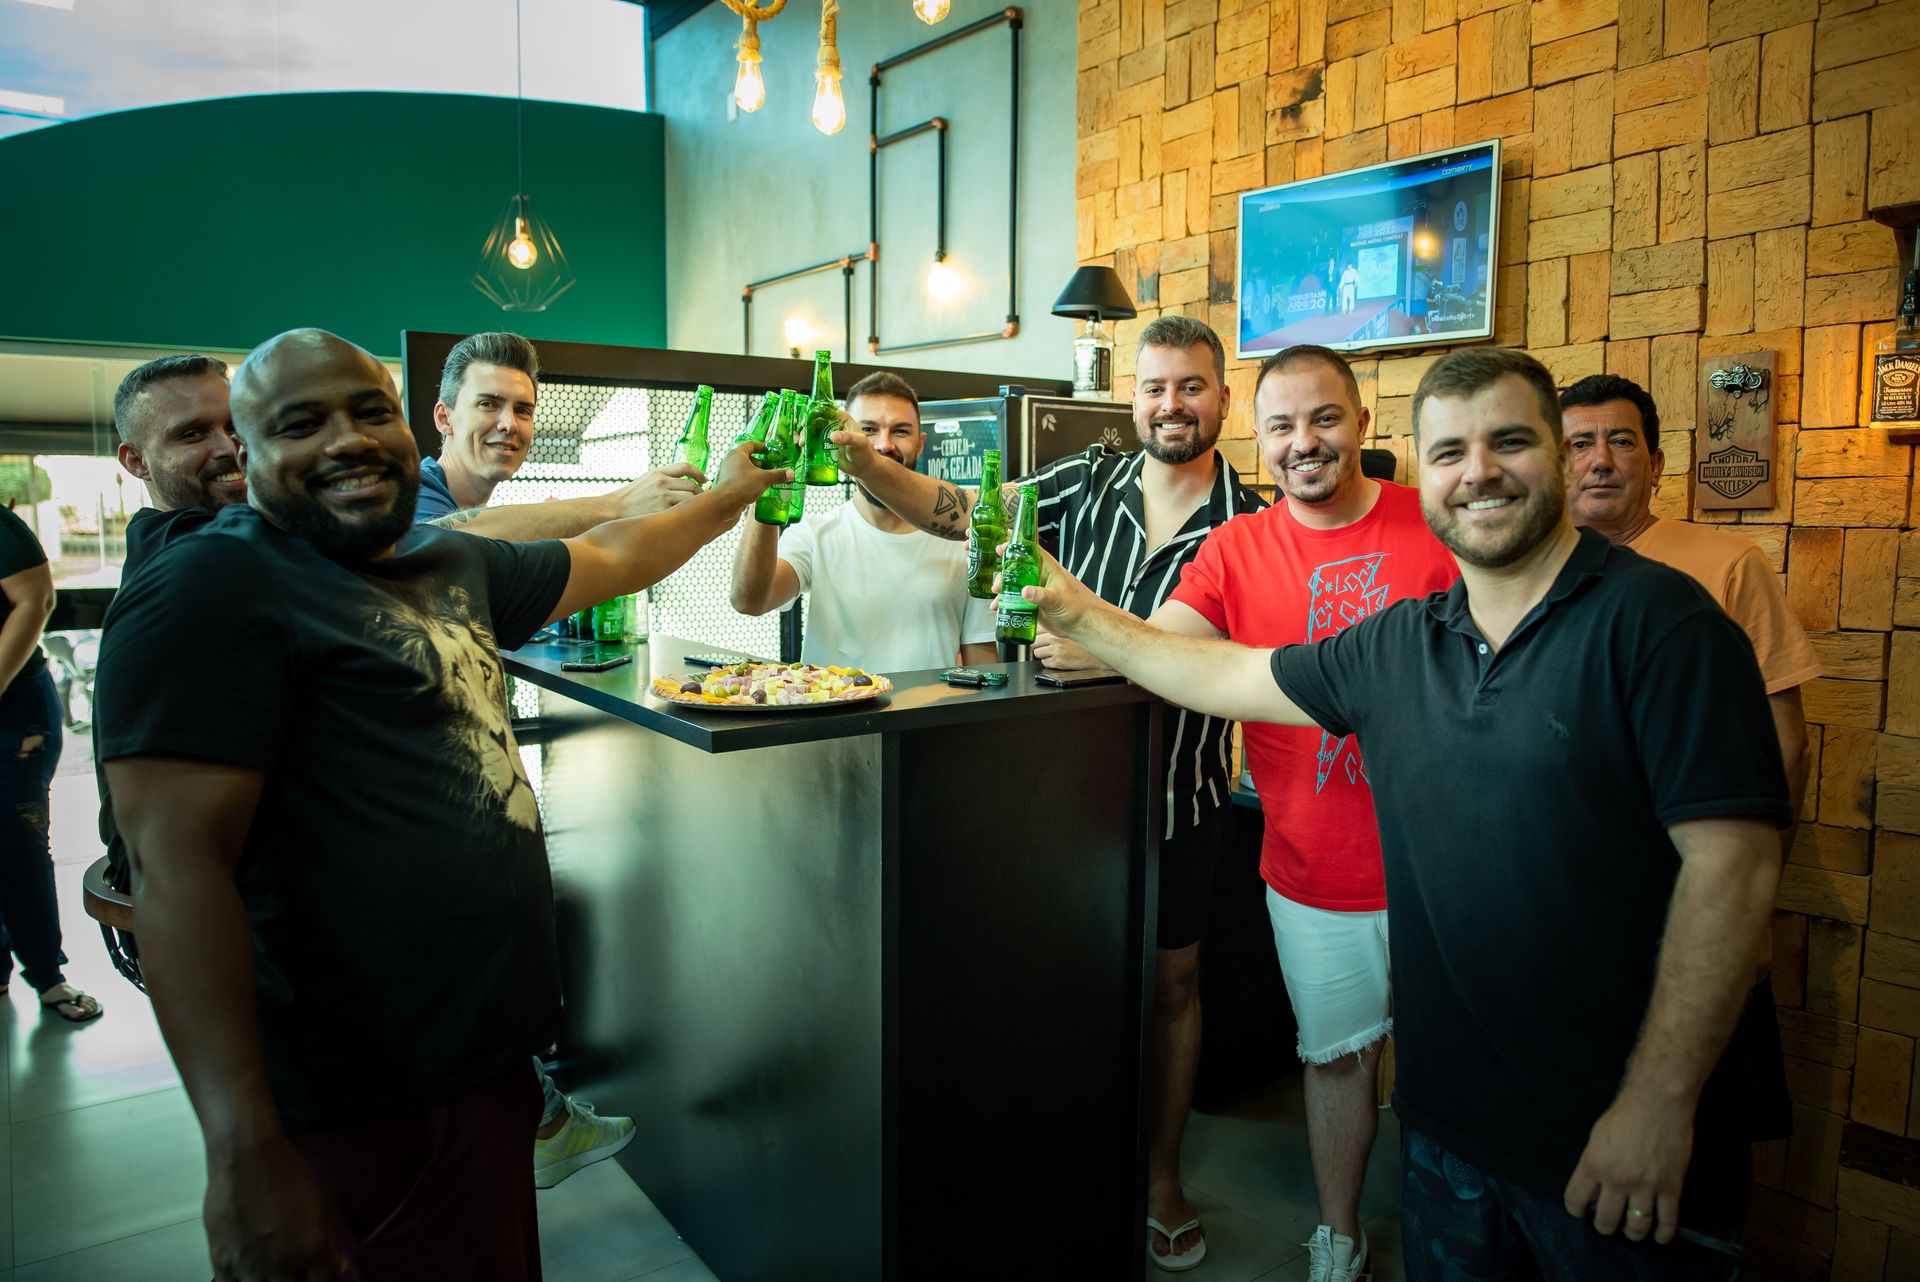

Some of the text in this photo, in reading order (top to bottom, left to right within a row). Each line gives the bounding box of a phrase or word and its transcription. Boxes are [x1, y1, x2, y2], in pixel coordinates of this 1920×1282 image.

[1287, 300, 1309, 311] JUDO
[1877, 361, 1895, 376] JACK
[941, 438, 969, 456] CERVEJA
[1718, 453, 1749, 464] MOTOR
[928, 456, 982, 480] 100% GELADA
[1704, 466, 1763, 478] HARLEY-DAVIDSON
[1717, 480, 1748, 493] CYCLES
